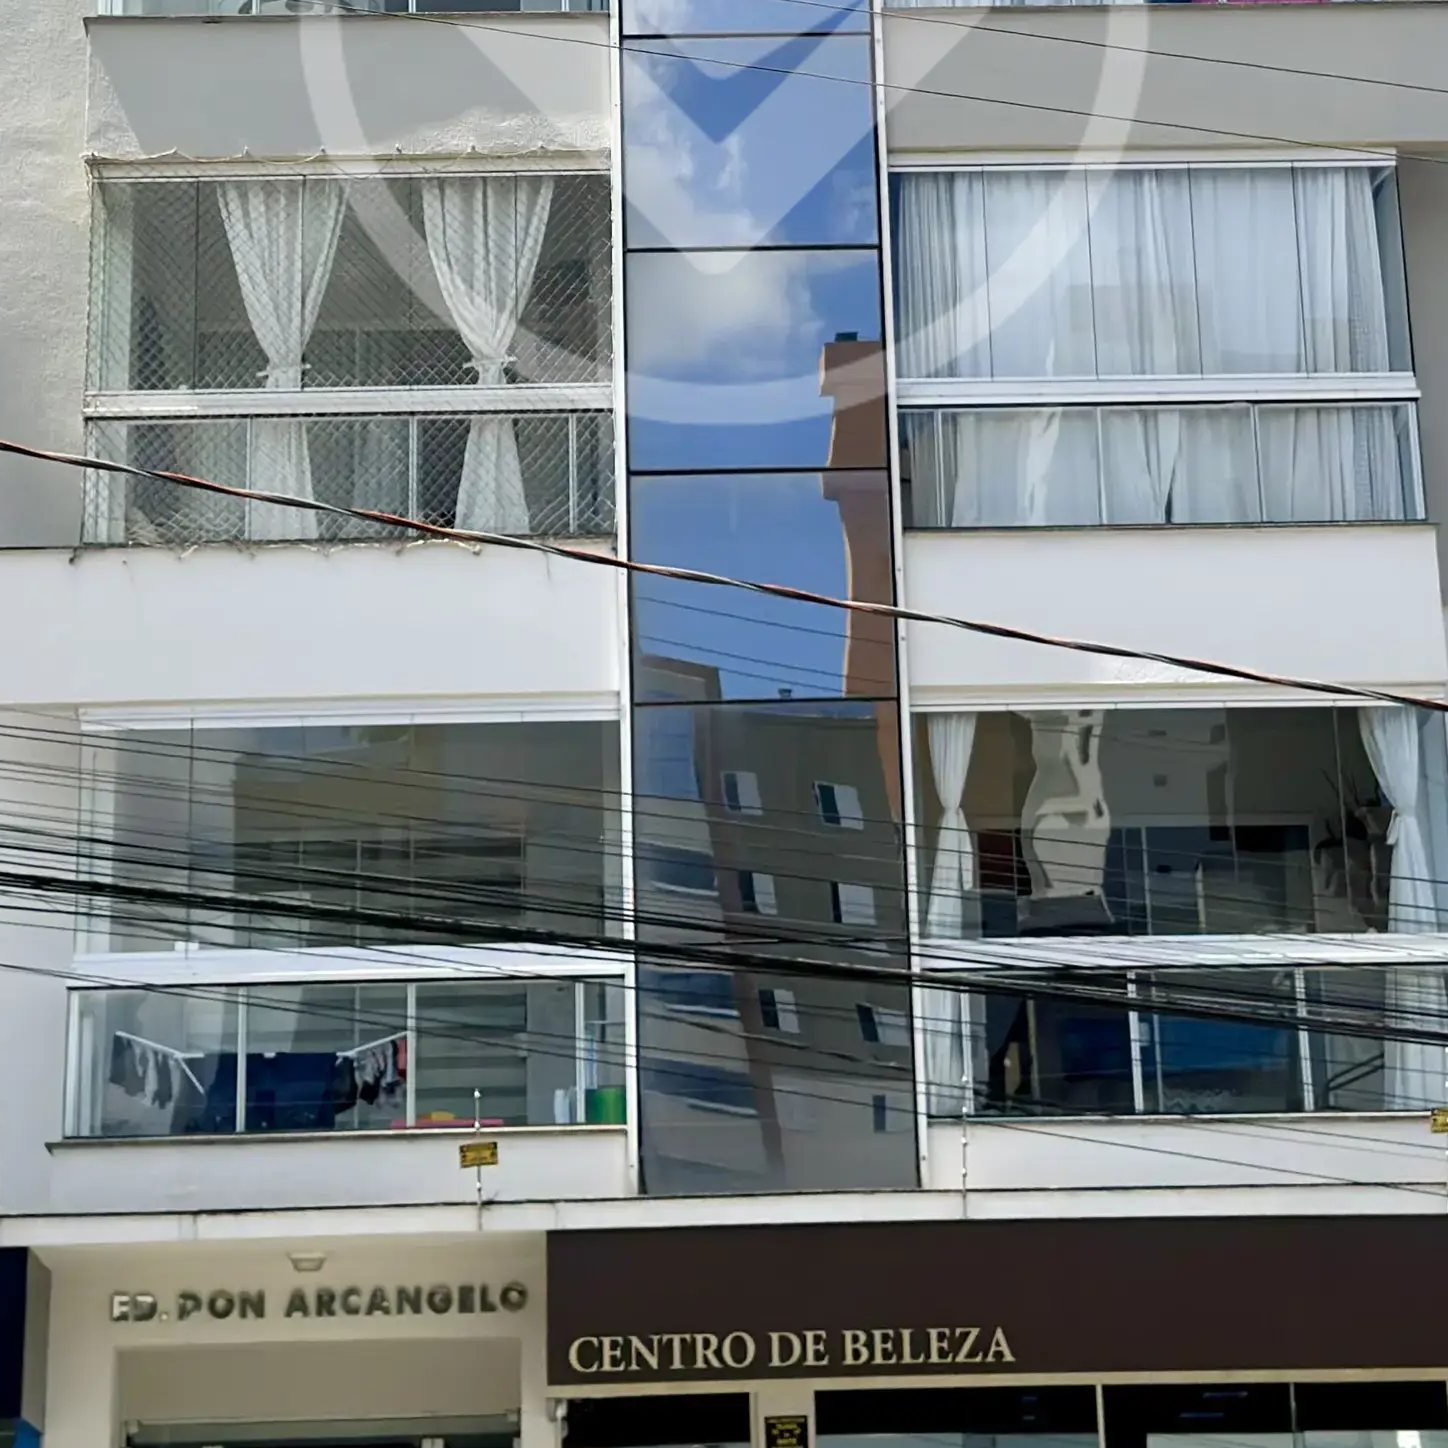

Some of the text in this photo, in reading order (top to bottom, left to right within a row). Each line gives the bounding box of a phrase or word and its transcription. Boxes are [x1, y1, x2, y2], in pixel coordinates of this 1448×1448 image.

[284, 1281, 528, 1318] ARCANGELO
[568, 1326, 1016, 1373] CENTRO DE BELEZA
